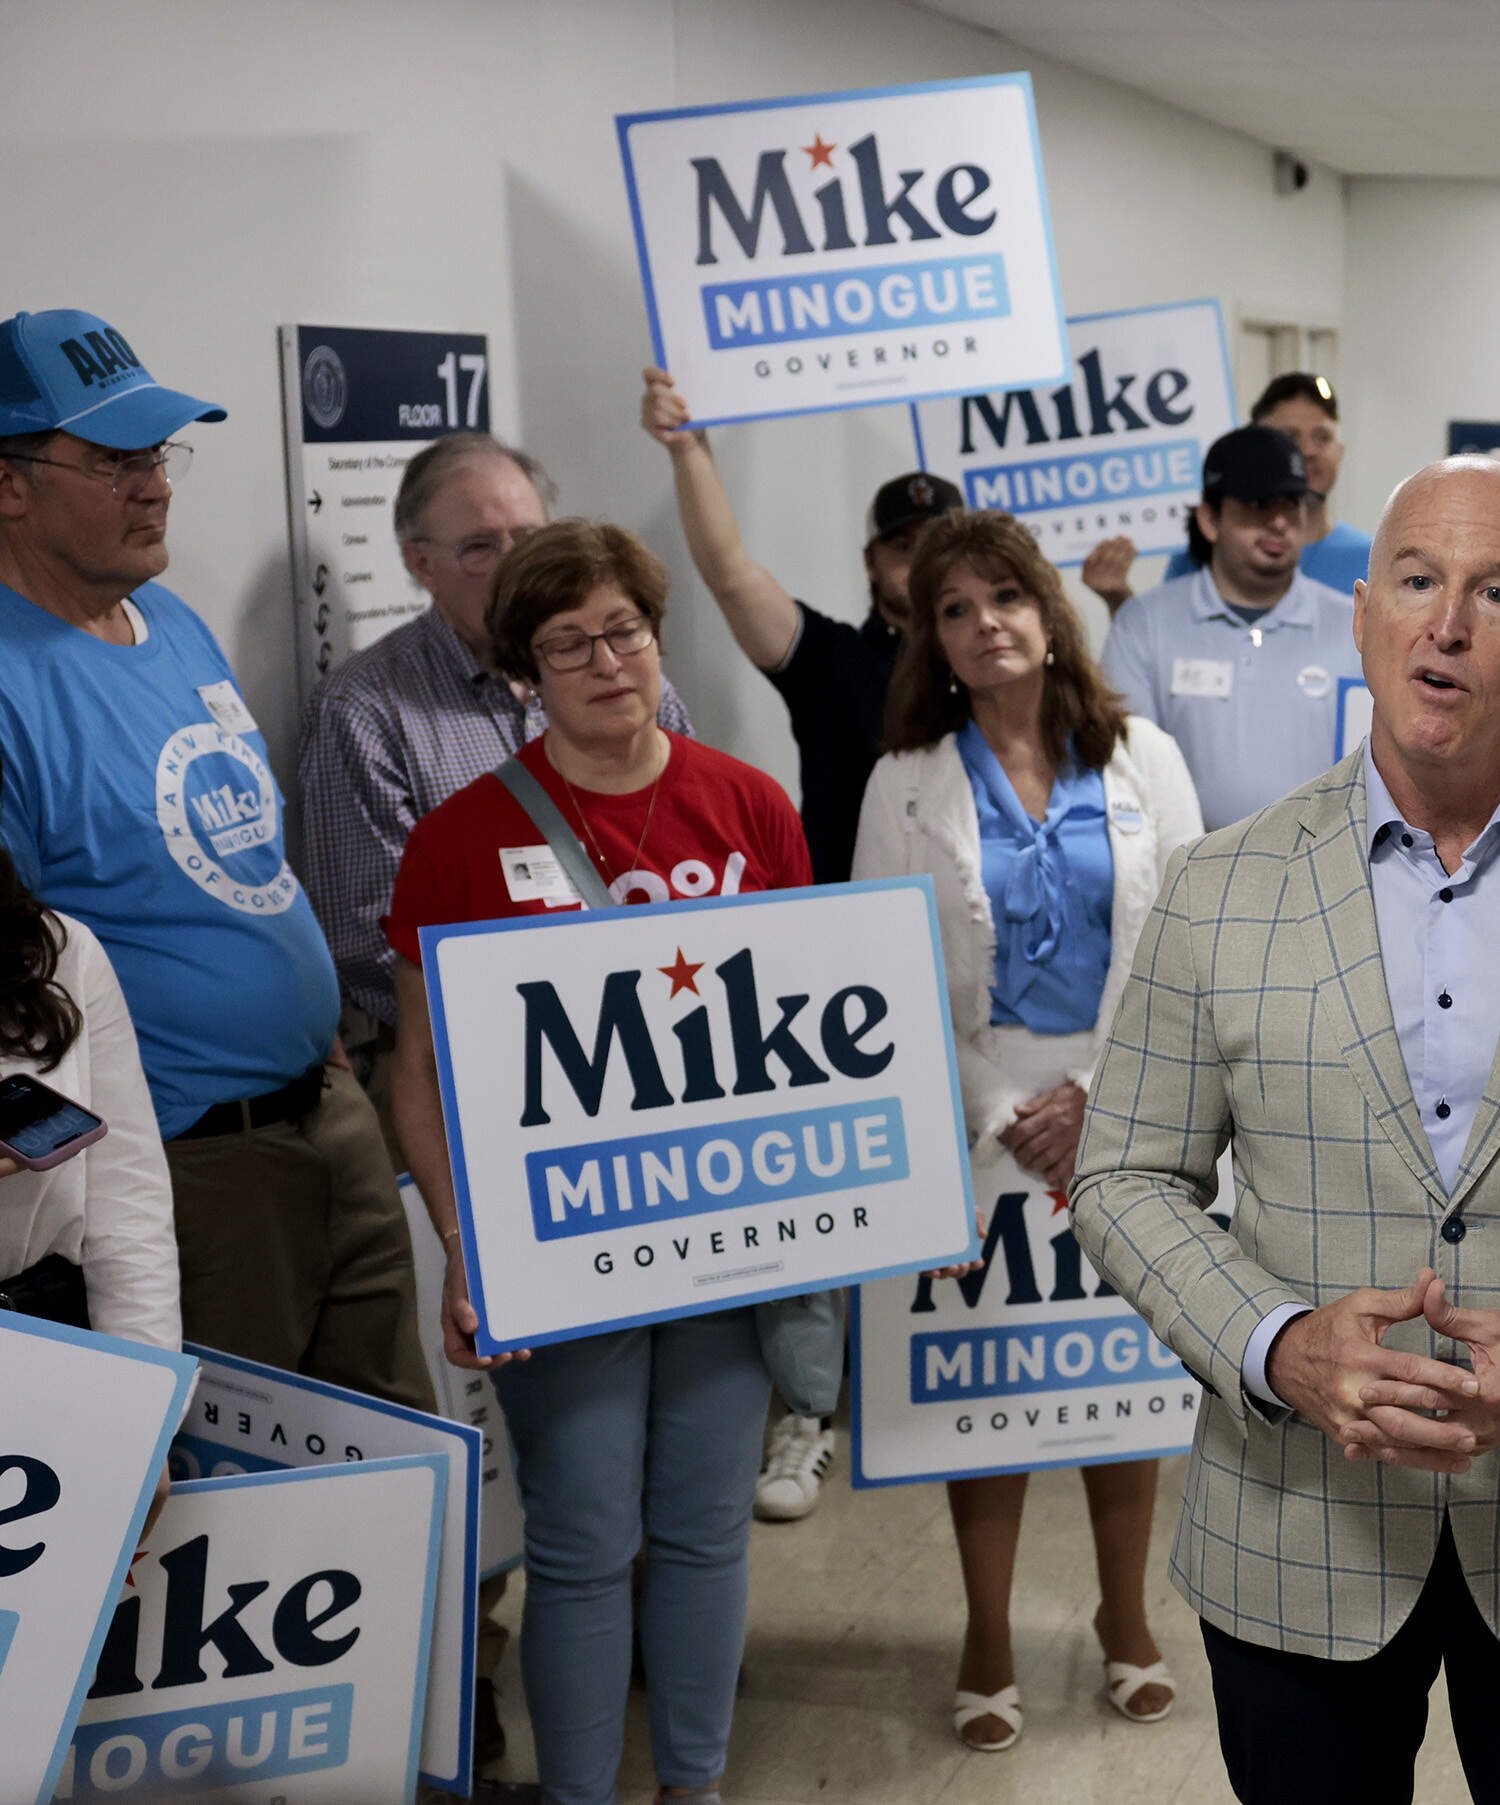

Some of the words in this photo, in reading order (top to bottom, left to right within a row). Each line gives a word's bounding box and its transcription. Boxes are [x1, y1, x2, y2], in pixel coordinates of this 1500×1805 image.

[689, 131, 998, 266] Mike
[714, 265, 997, 339] MINOGUE
[398, 404, 442, 428] FLOOR
[437, 351, 486, 429] 17
[754, 336, 977, 379] GOVERNOR
[960, 347, 1194, 456] Mike
[973, 448, 1196, 509] MINOGUE
[1031, 505, 1179, 538] OVERNOR
[516, 946, 896, 1128] Mike
[544, 1114, 892, 1224] MINOGUE
[594, 1206, 869, 1275] GOVERNOR
[910, 1189, 1120, 1313] Mi
[925, 1327, 1182, 1392] MINOGU
[204, 1401, 364, 1465] GOVER
[956, 1393, 1195, 1434] GOVERNOR
[88, 1533, 362, 1700] ike
[55, 1702, 333, 1799] OGUE
